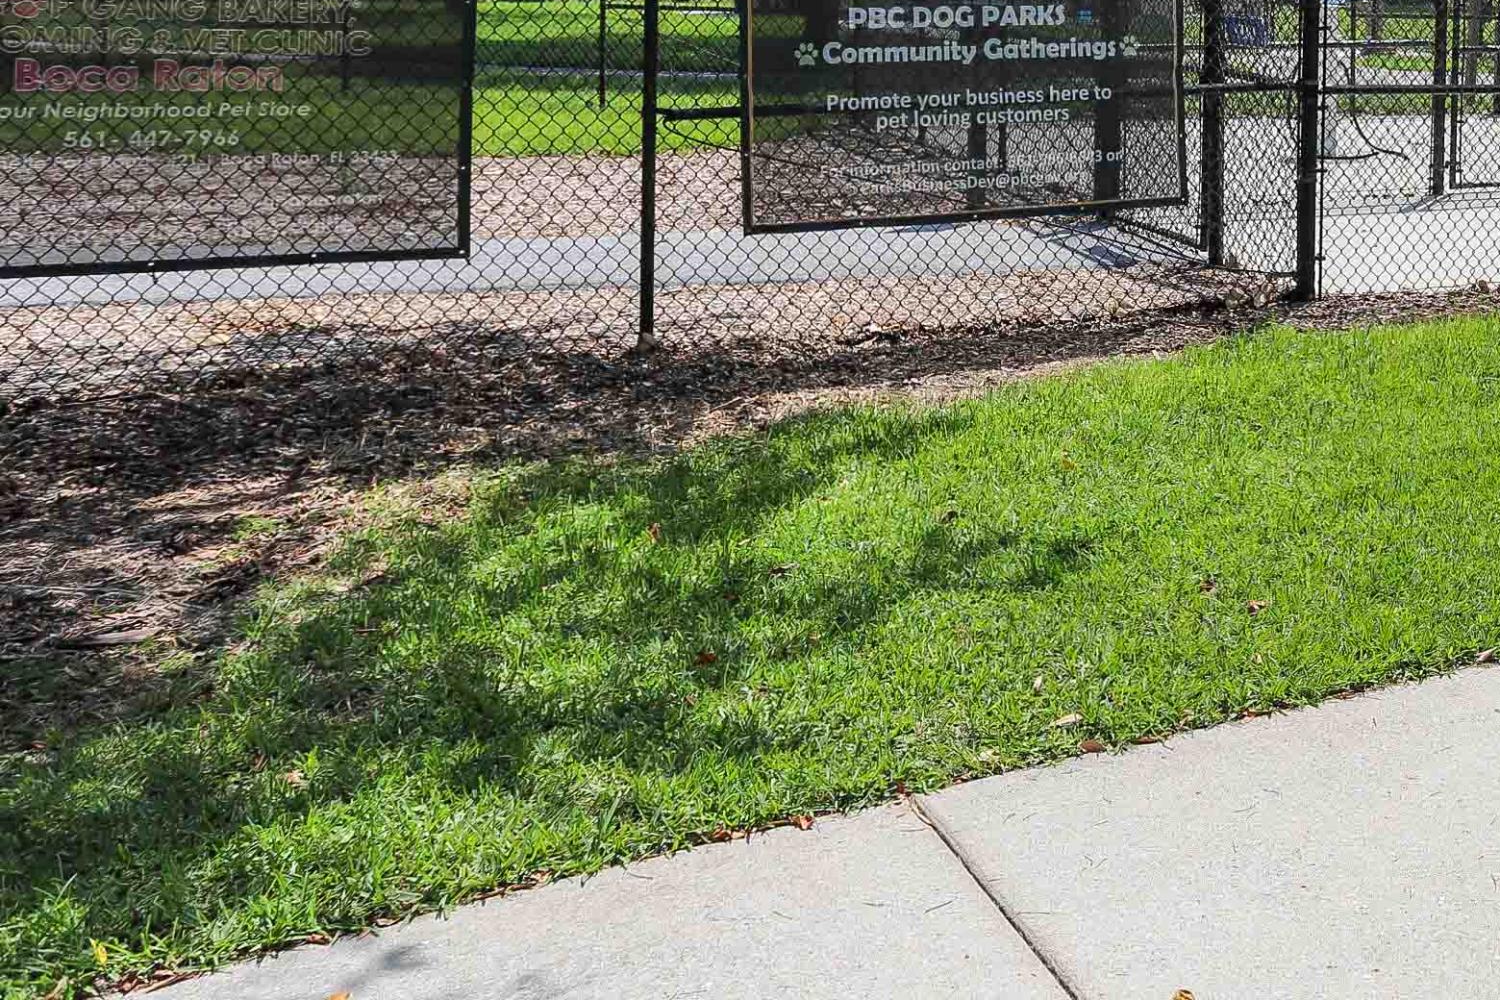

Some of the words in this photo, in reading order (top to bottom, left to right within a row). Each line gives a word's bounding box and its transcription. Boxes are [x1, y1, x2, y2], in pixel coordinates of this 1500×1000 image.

[848, 6, 906, 30] PBC
[911, 5, 975, 29] DOG
[981, 4, 1067, 27] PARKS
[147, 28, 177, 55] &
[180, 28, 248, 56] VET
[252, 29, 374, 58] CLINIC
[822, 39, 977, 65] Community
[983, 36, 1117, 61] Gatherings
[14, 57, 140, 93] Boca
[153, 57, 285, 94] Raton
[42, 101, 211, 122] Neighborhood
[218, 102, 253, 118] Pet
[258, 101, 312, 118] Store
[826, 92, 912, 112] Promote
[917, 93, 961, 110] your
[966, 87, 1044, 107] business
[1049, 85, 1090, 103] here
[1093, 85, 1113, 101] to
[876, 109, 910, 133] pet
[914, 107, 970, 129] loving
[976, 107, 1071, 124] customers
[128, 129, 240, 148] 447-7966
[330, 150, 346, 164] FL
[849, 159, 941, 178] information
